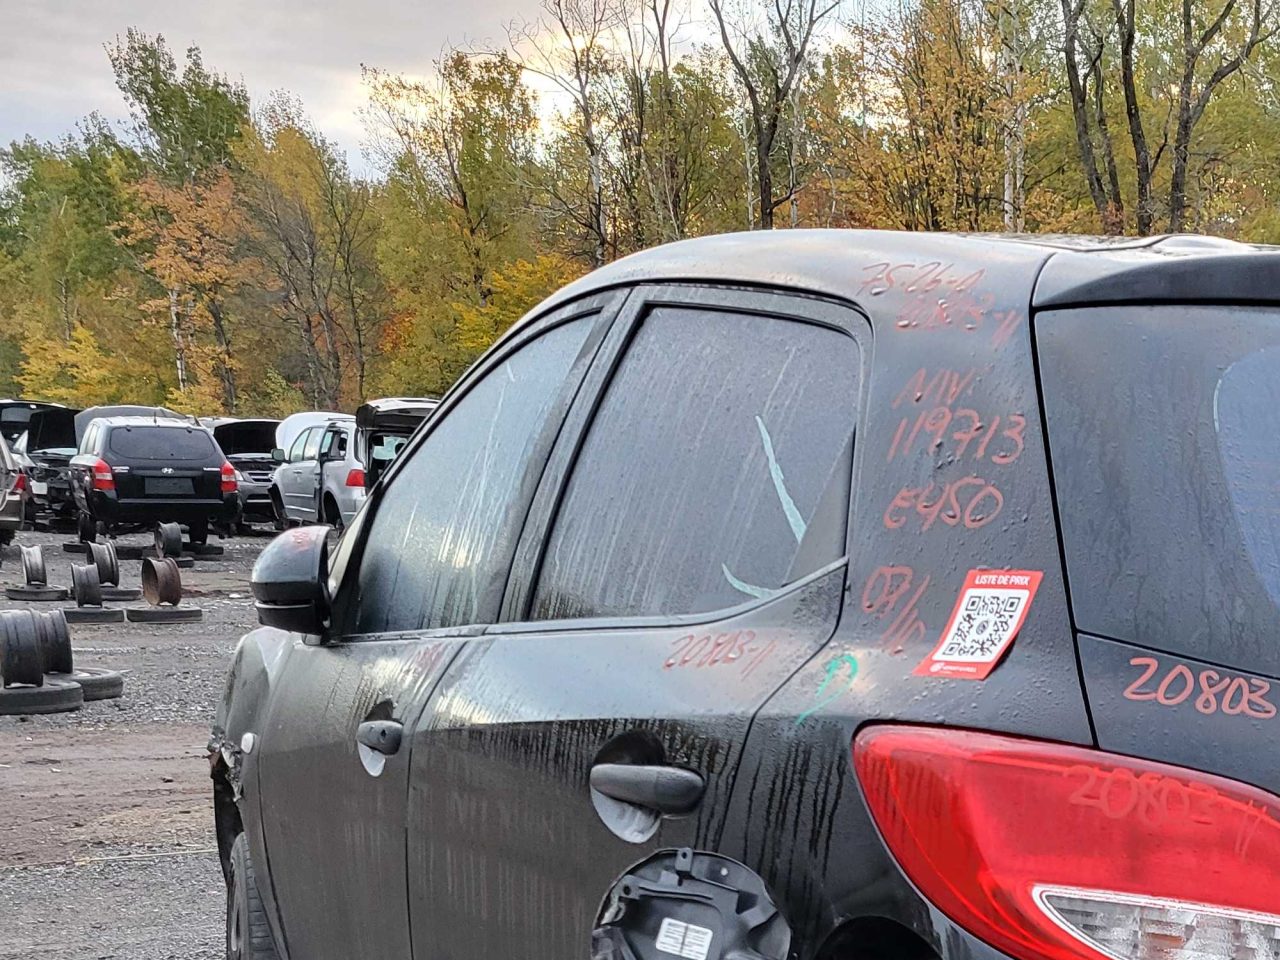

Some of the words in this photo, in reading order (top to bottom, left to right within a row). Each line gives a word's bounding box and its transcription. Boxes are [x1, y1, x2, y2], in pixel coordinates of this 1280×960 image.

[886, 406, 1027, 465] 119713
[974, 575, 997, 585] LISTE
[997, 575, 1010, 586] DE
[1009, 575, 1031, 586] PRIX
